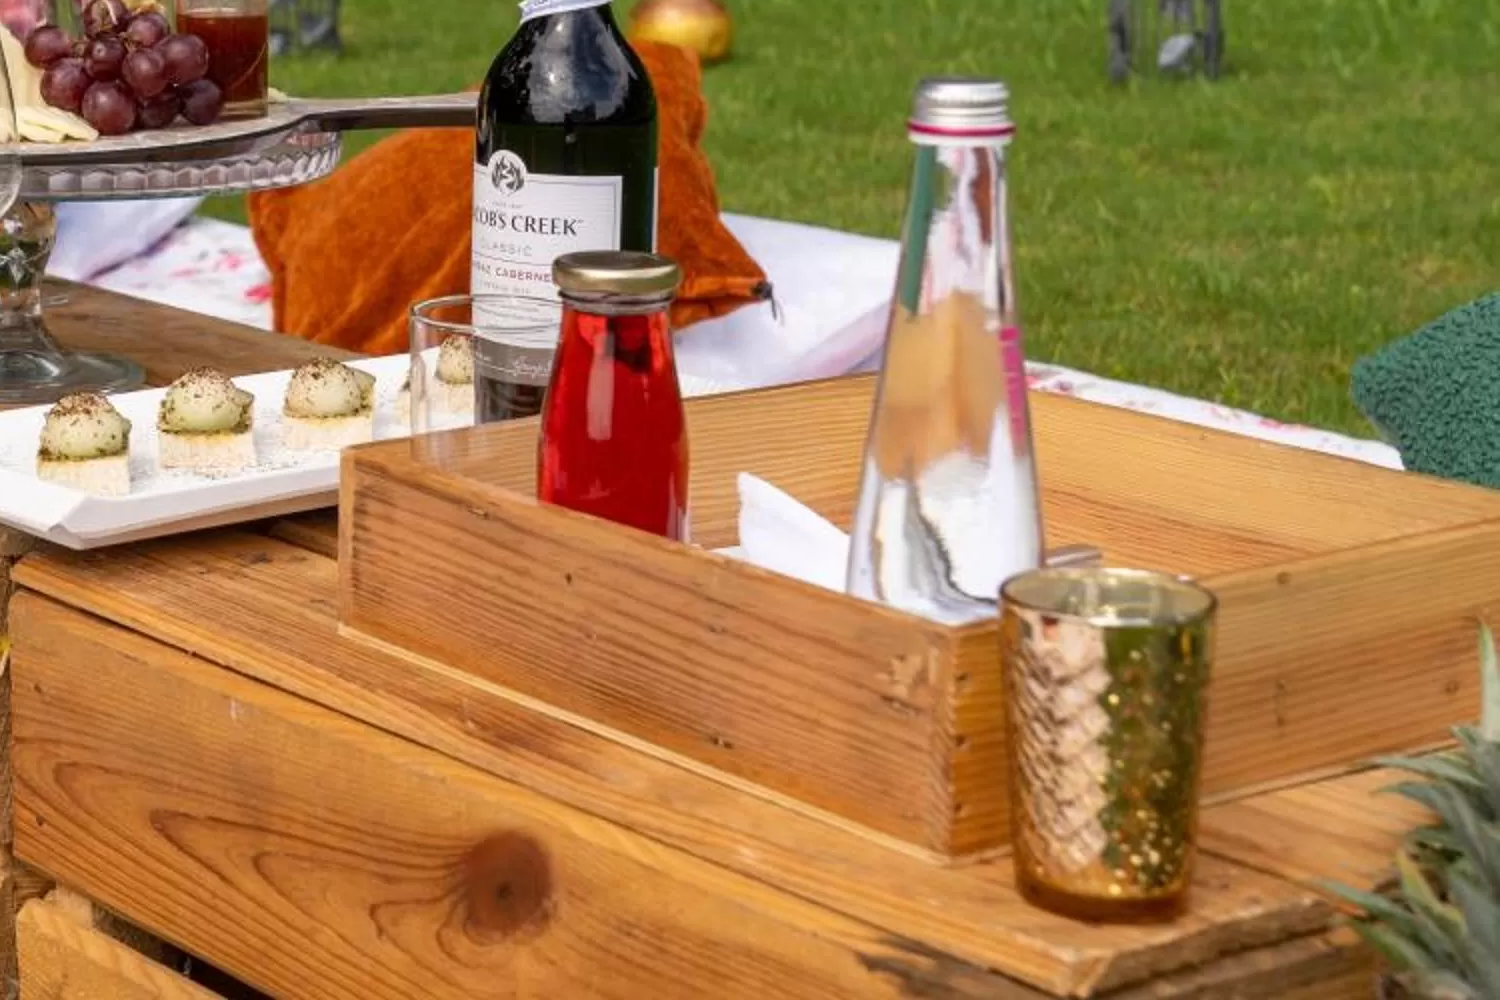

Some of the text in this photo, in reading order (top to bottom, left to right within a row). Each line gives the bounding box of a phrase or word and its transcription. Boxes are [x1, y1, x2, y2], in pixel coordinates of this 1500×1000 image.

[475, 206, 578, 235] COB'S CREEK
[495, 268, 552, 282] CABERNE
